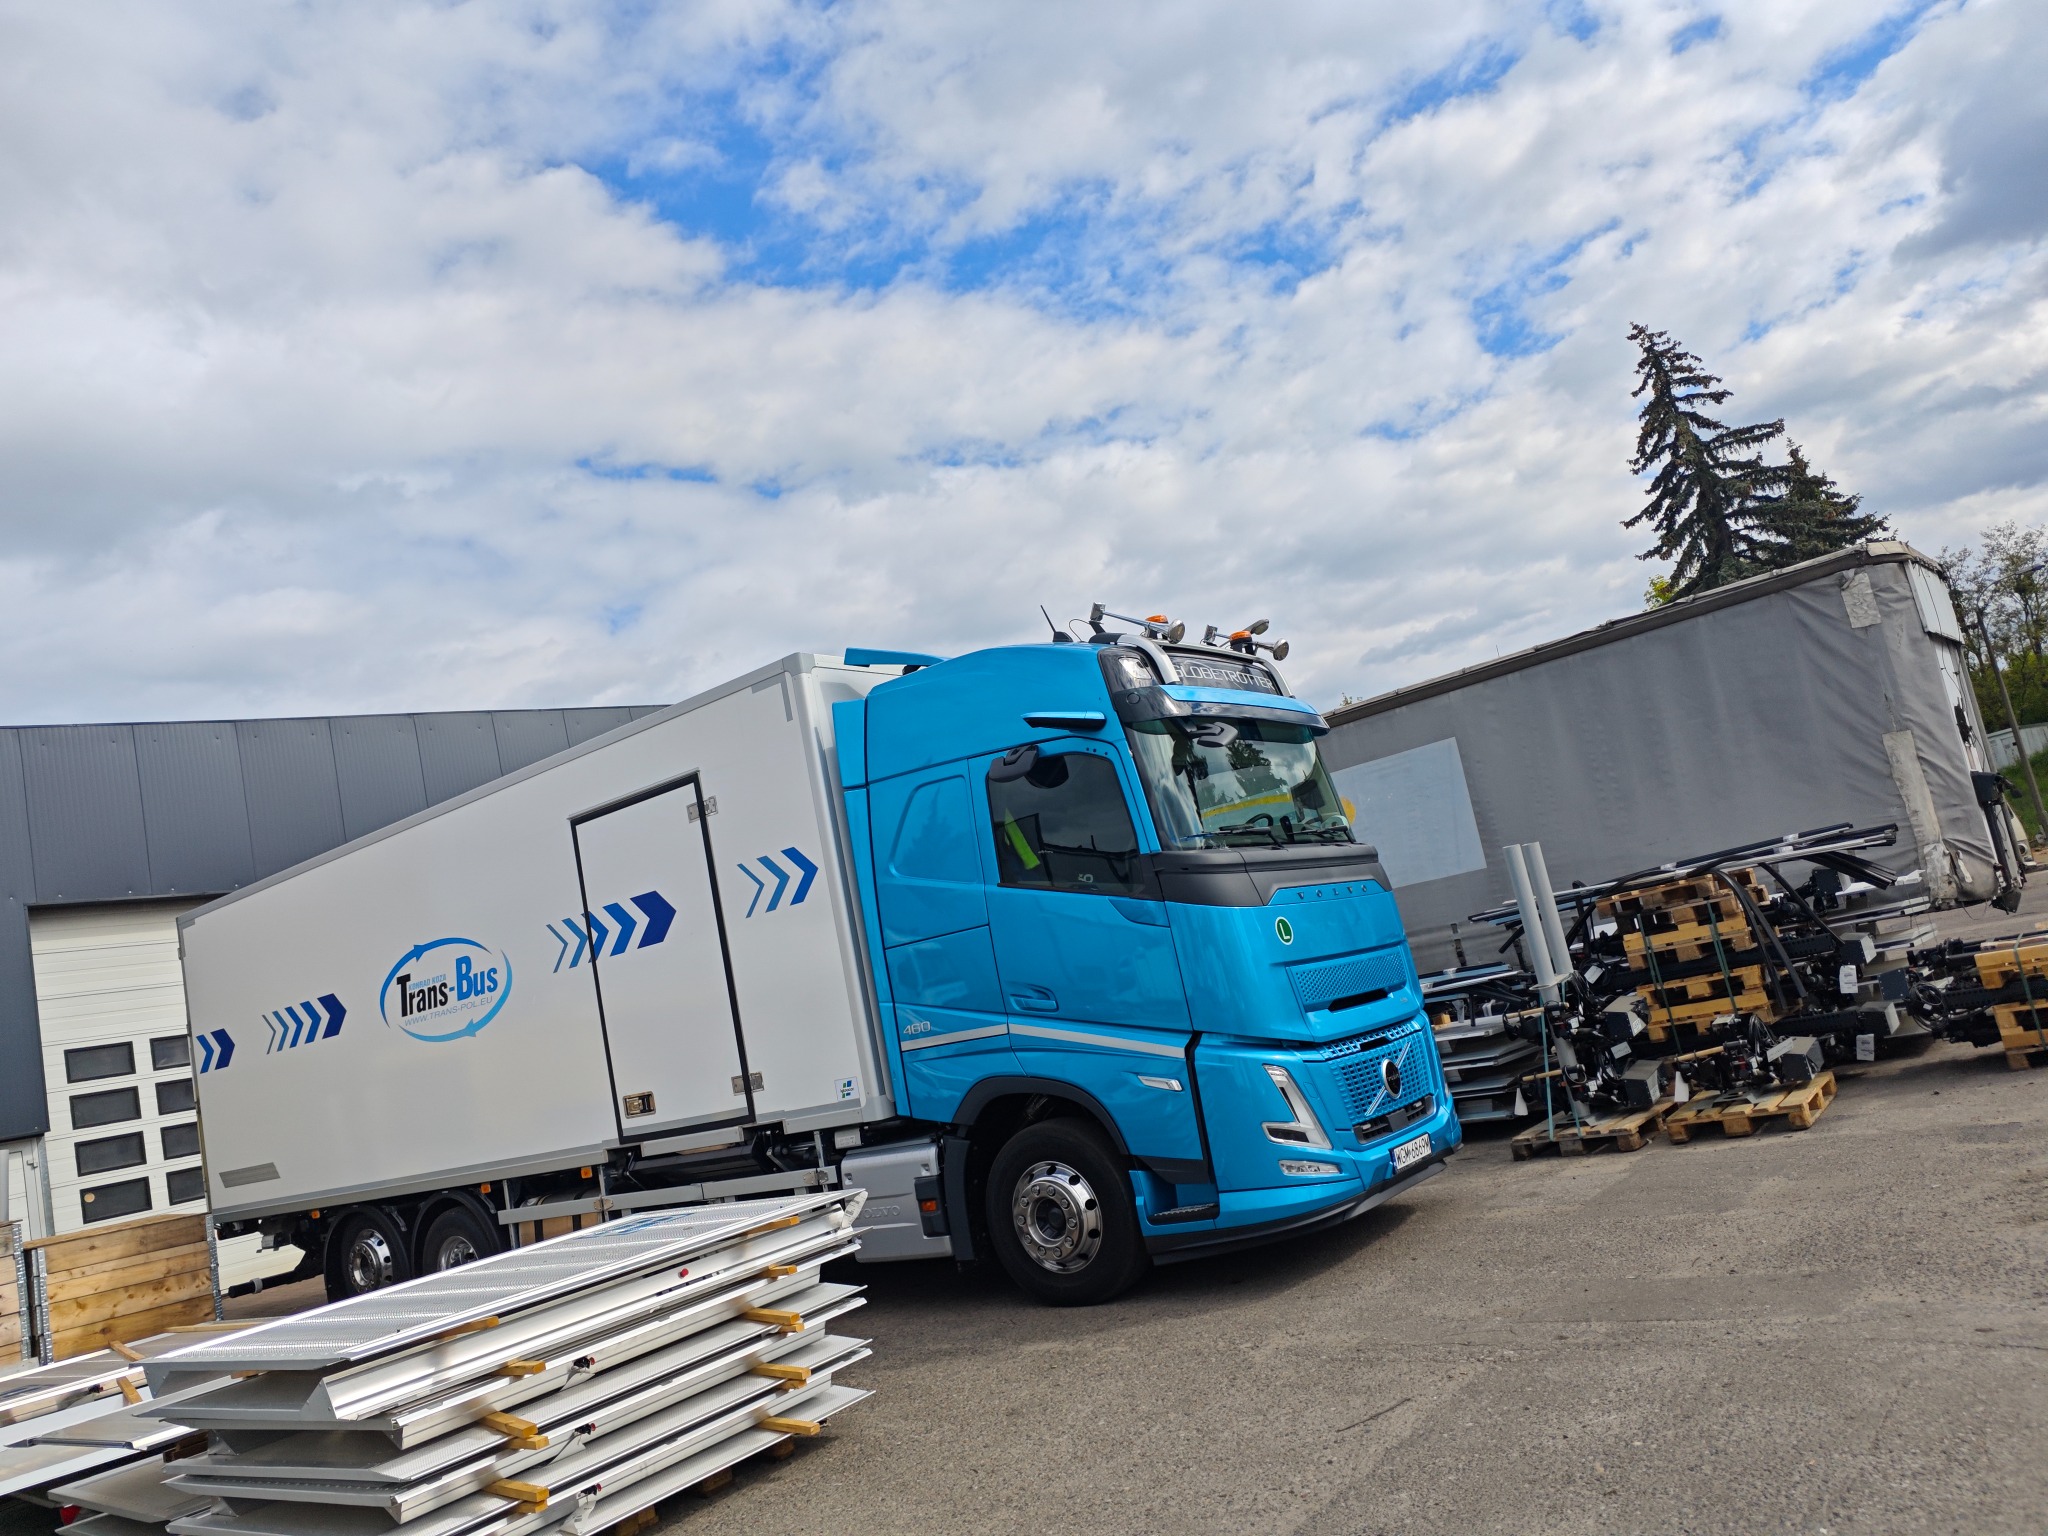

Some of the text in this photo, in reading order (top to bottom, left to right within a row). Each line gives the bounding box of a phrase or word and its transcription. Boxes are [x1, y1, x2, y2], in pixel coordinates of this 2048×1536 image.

[1173, 664, 1276, 690] GLOBETROTTER
[1297, 884, 1368, 900] VOLVO
[1279, 922, 1291, 940] L
[396, 955, 498, 1018] Trans-Bus
[408, 973, 447, 991] KONRAD KOZA
[404, 996, 493, 1026] WWW.TRANS-POL.EU
[903, 1021, 931, 1035] 460
[859, 1204, 901, 1219] OLVO
